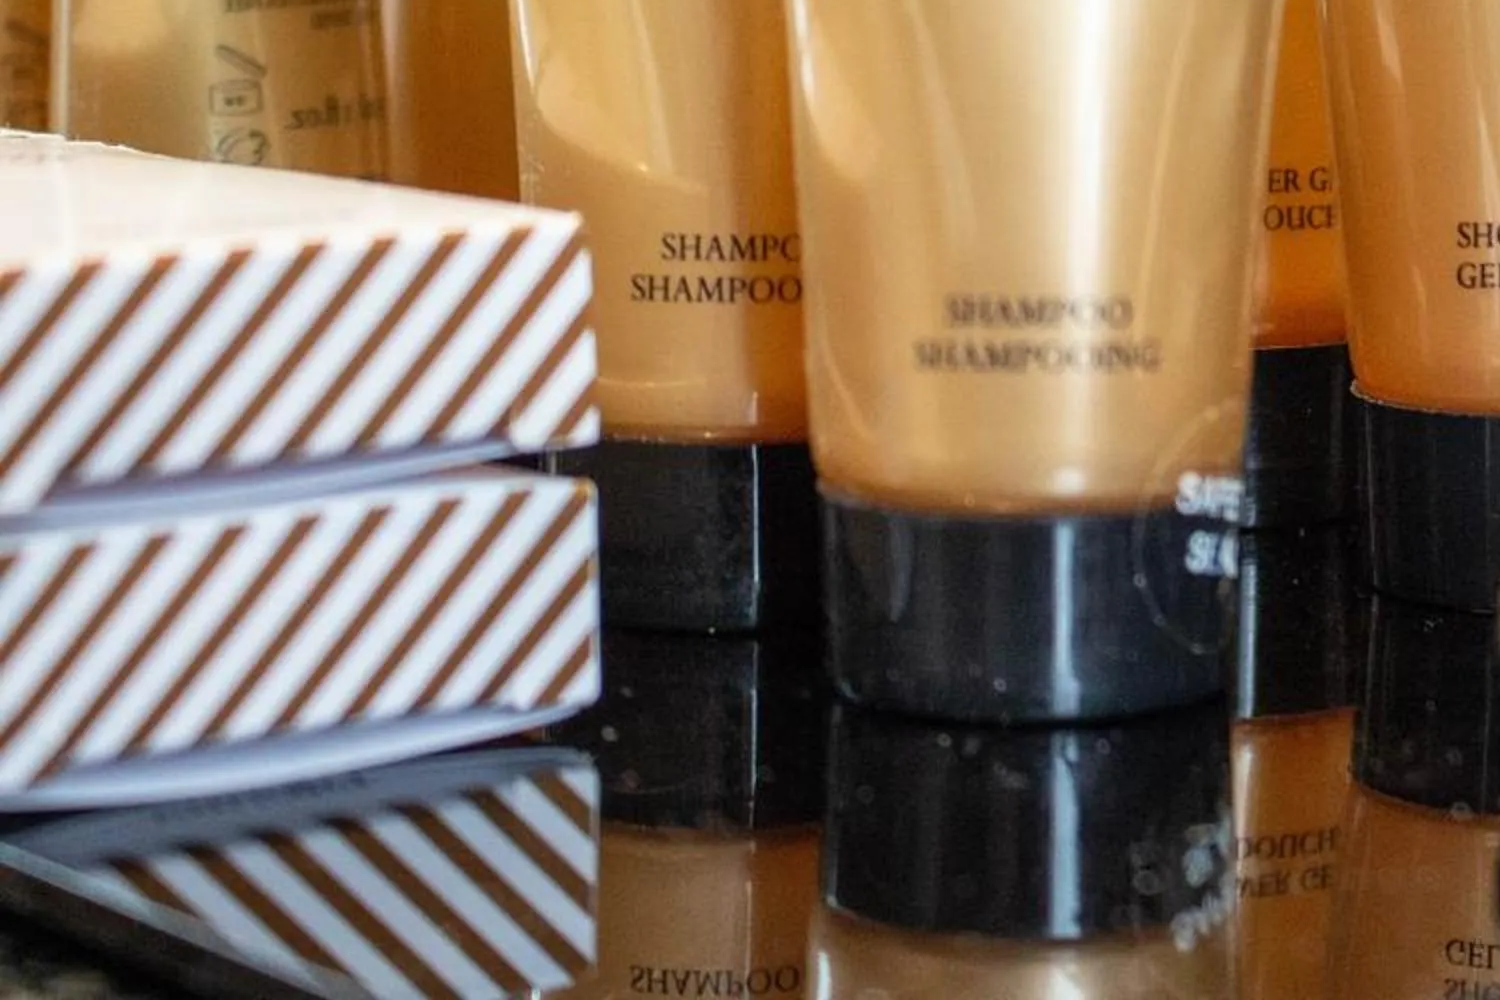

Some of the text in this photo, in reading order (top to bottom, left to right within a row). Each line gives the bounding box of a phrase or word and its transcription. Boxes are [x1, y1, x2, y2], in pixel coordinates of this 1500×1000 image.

[660, 232, 800, 264] SHAMPO
[630, 273, 803, 304] SHAMPOO
[945, 294, 1136, 333] SHAMPOO
[913, 337, 1164, 373] SHAMPOOING
